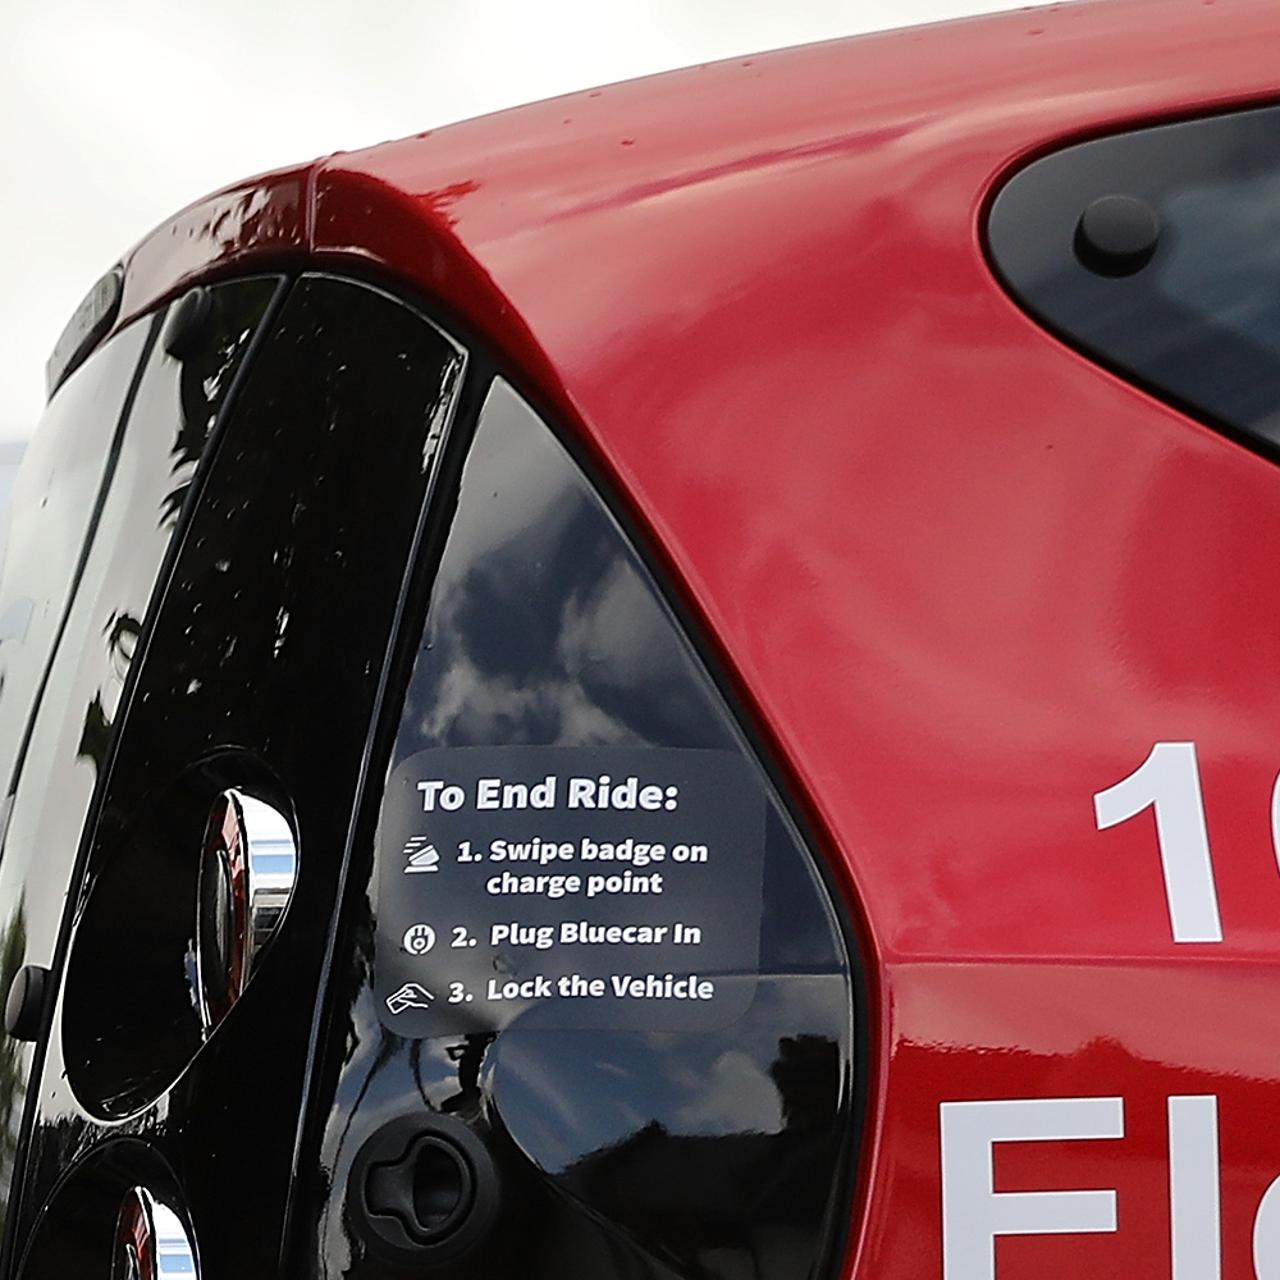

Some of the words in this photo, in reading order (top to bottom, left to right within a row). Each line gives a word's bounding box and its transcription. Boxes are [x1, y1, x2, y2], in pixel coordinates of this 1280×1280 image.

[417, 780, 465, 811] To
[476, 776, 557, 810] End
[568, 775, 678, 811] Ride:
[457, 841, 483, 862] 1.
[489, 838, 575, 865] Swipe
[580, 838, 666, 866] badge
[672, 845, 708, 862] on
[1093, 741, 1280, 942] 1
[486, 871, 581, 898] charge
[587, 870, 663, 897] point
[451, 926, 477, 948] 2.
[491, 922, 554, 949] Plug
[560, 921, 669, 944] Bluecar
[673, 923, 701, 944] In
[448, 982, 474, 1003] 3.
[487, 975, 553, 1001] Lock
[557, 974, 605, 997] the
[611, 974, 714, 1000] Vehicle
